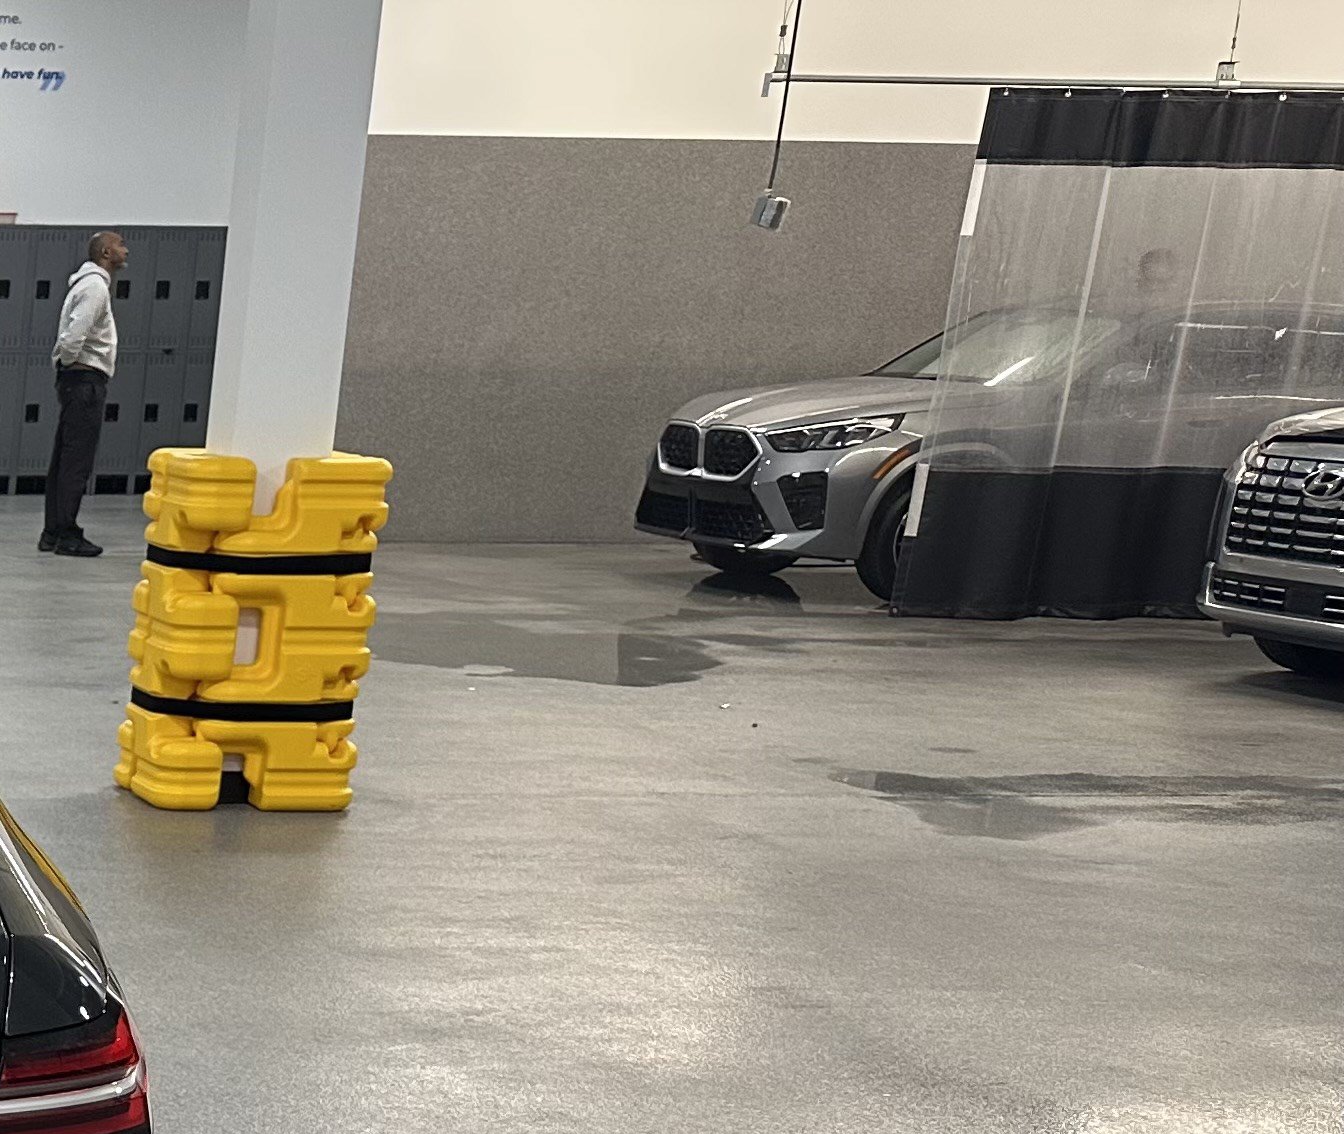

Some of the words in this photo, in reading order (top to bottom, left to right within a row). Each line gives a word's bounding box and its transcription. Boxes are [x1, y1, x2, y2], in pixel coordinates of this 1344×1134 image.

[10, 39, 37, 51] face
[39, 41, 56, 51] on
[1, 68, 34, 79] have
